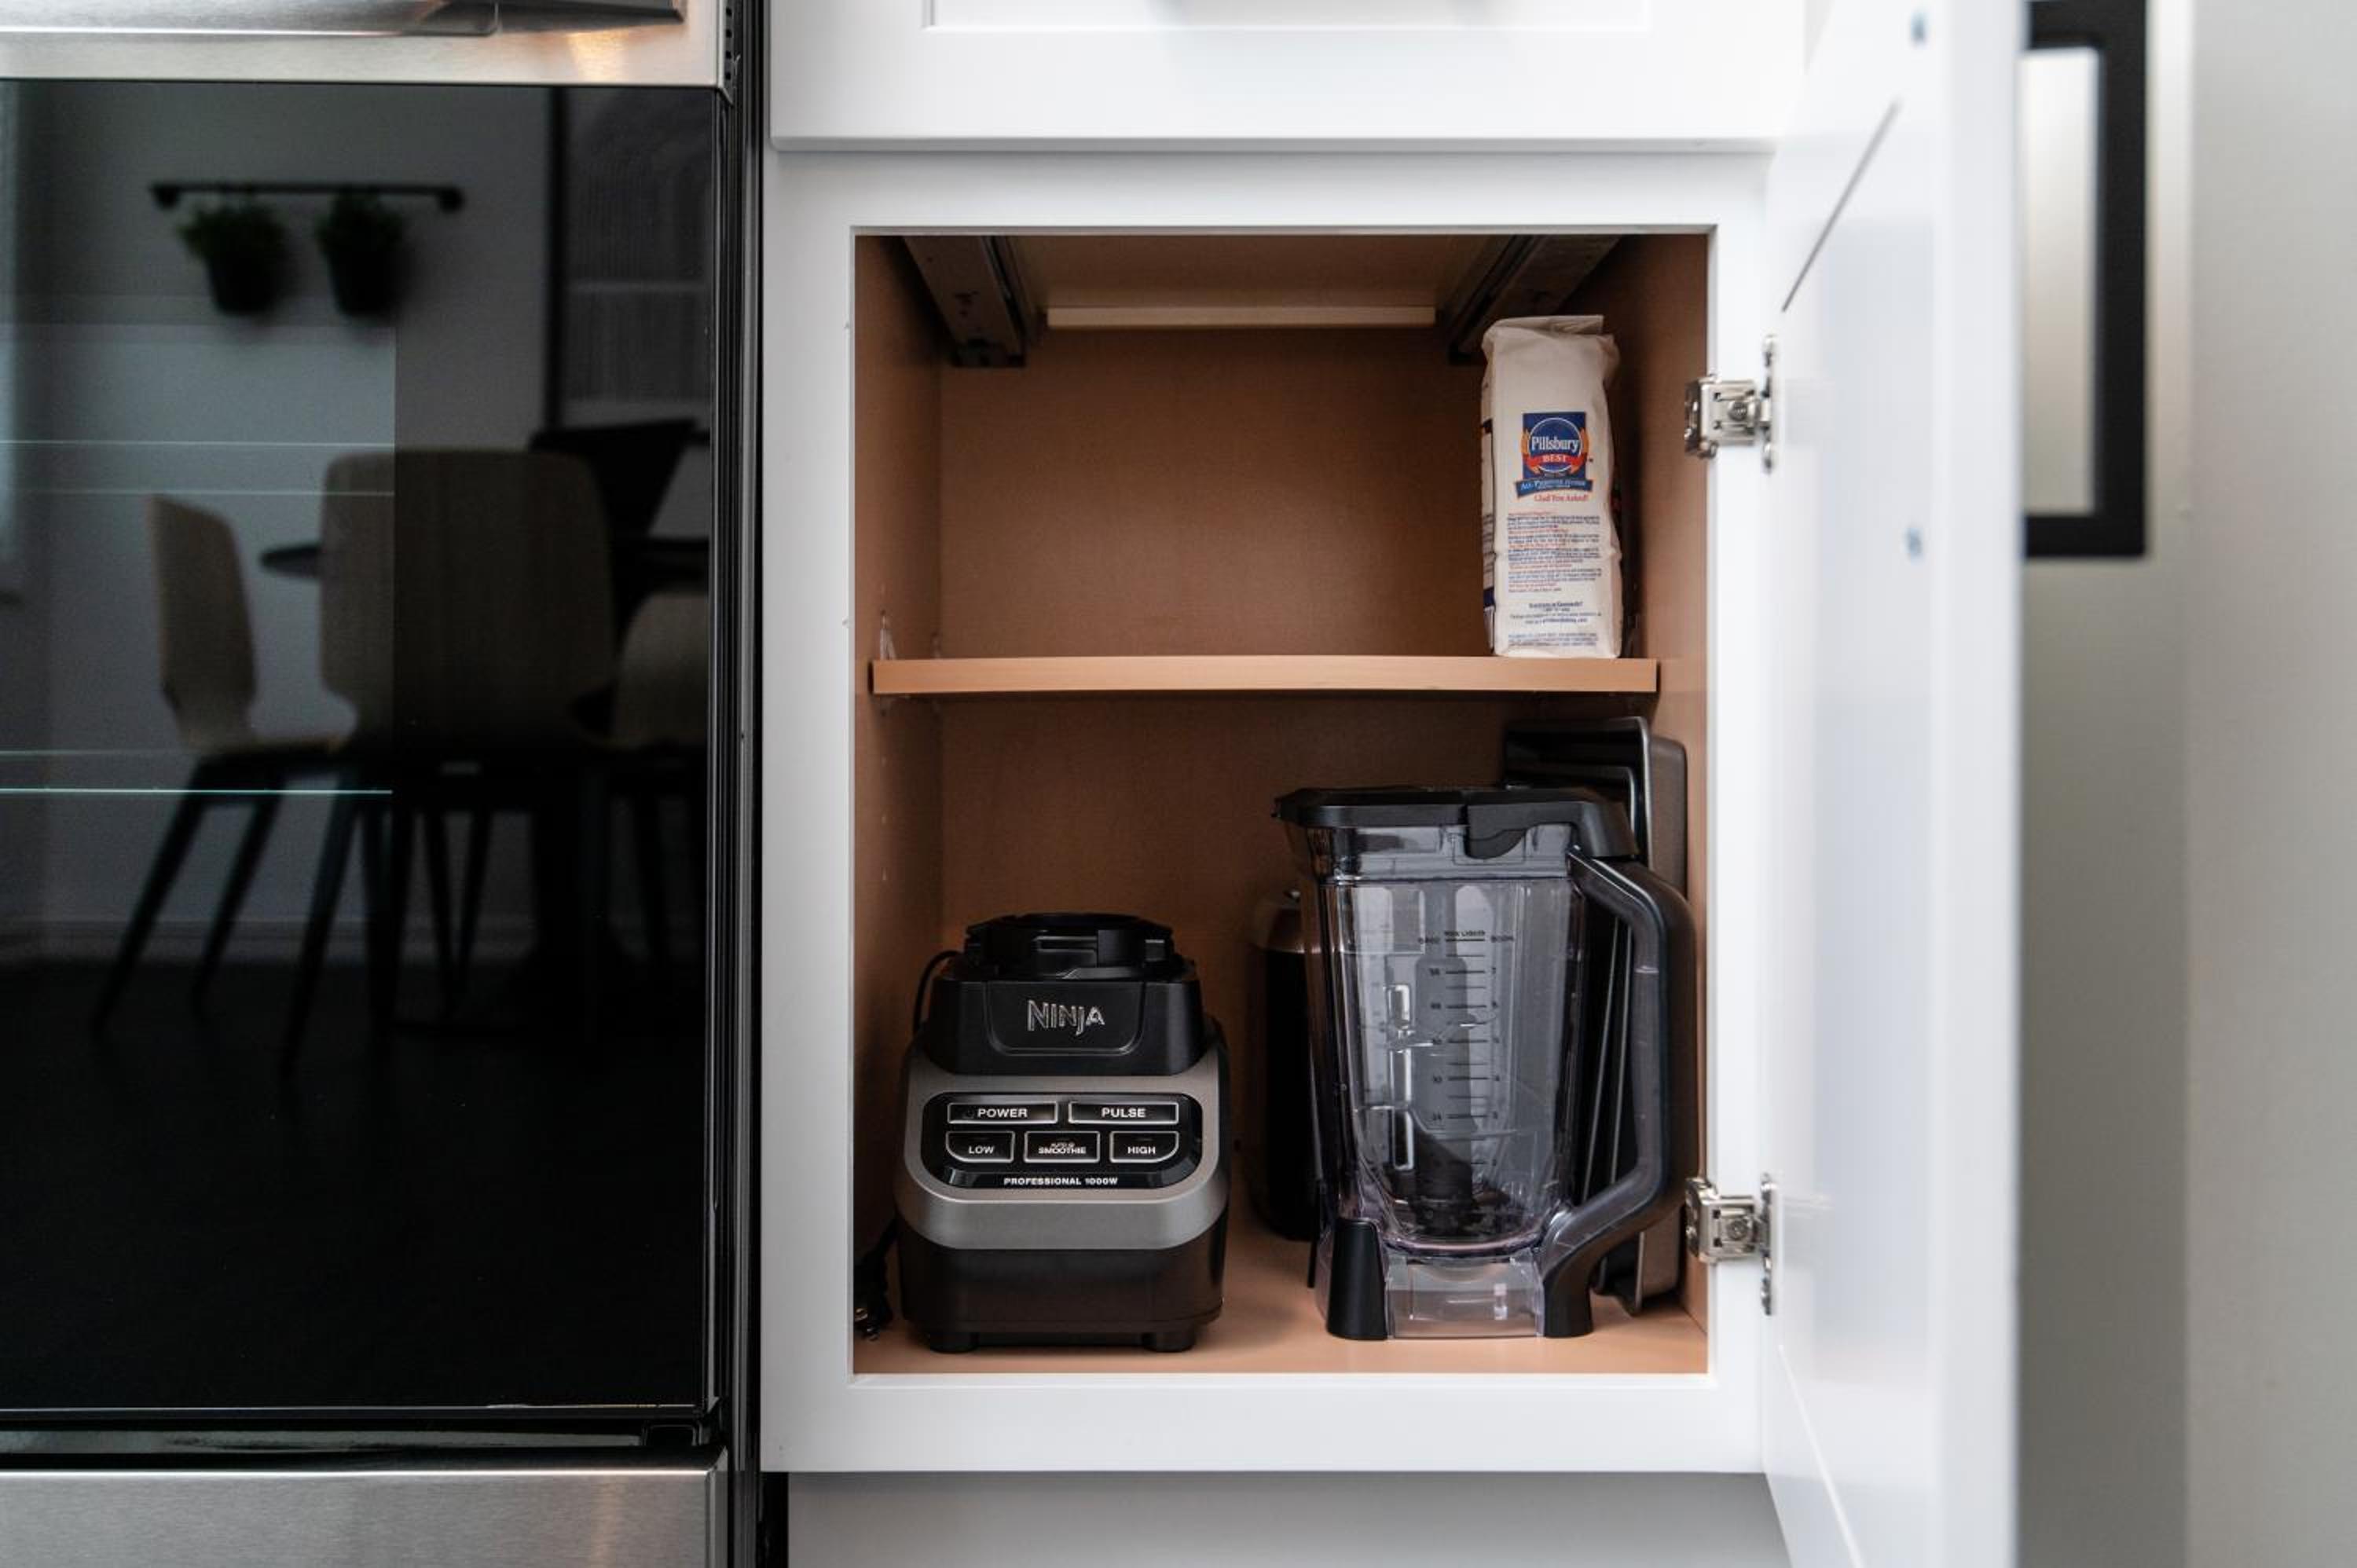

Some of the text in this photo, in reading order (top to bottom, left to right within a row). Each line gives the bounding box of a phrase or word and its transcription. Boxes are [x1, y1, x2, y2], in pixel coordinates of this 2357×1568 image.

[1531, 436, 1578, 453] Pillsbury
[1028, 999, 1105, 1035] NINJA
[977, 1108, 1028, 1118] POWER
[1102, 1107, 1146, 1118] PULSE
